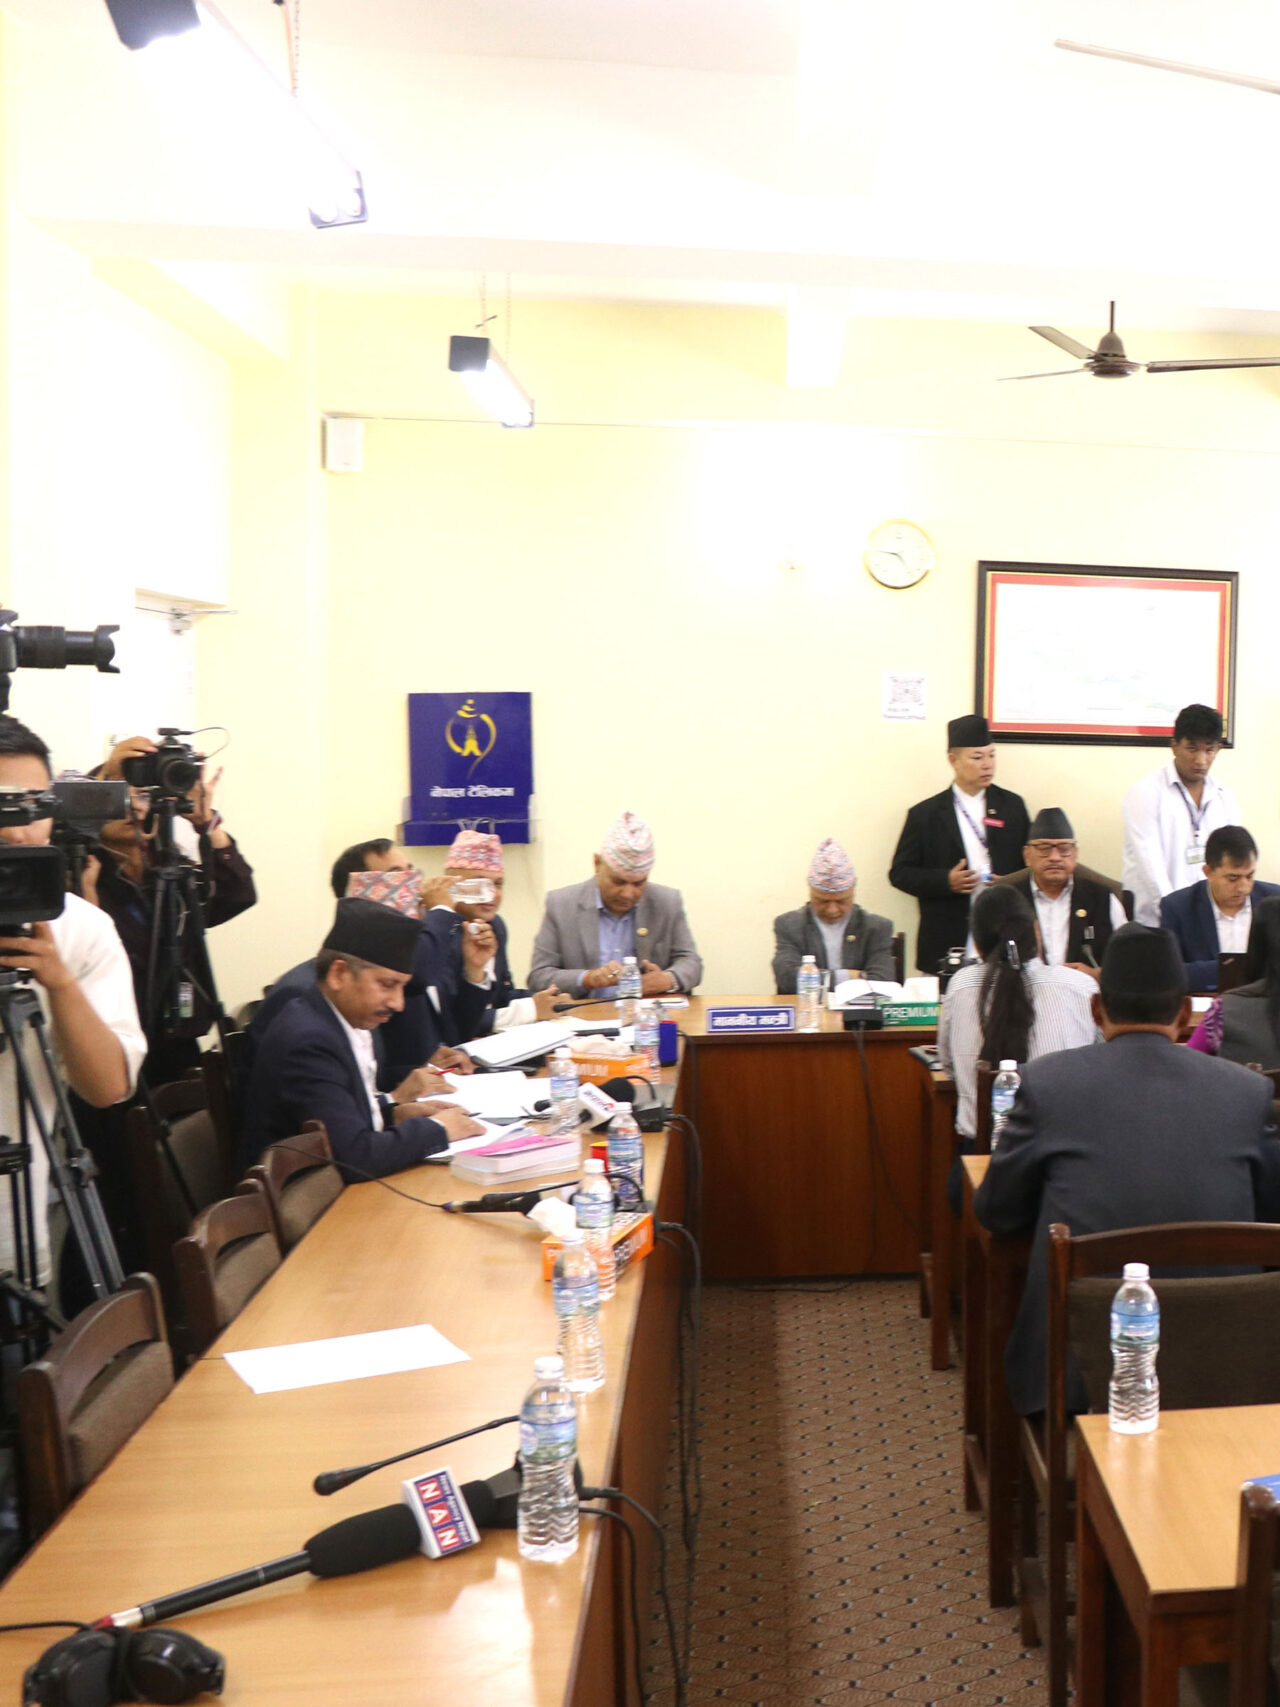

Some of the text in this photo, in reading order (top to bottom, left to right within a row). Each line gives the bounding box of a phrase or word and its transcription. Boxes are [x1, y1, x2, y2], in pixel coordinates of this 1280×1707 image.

[430, 784, 515, 797] नेपाल टेलिकम
[883, 1007, 939, 1018] PREMIUM
[419, 1480, 460, 1547] NAN
